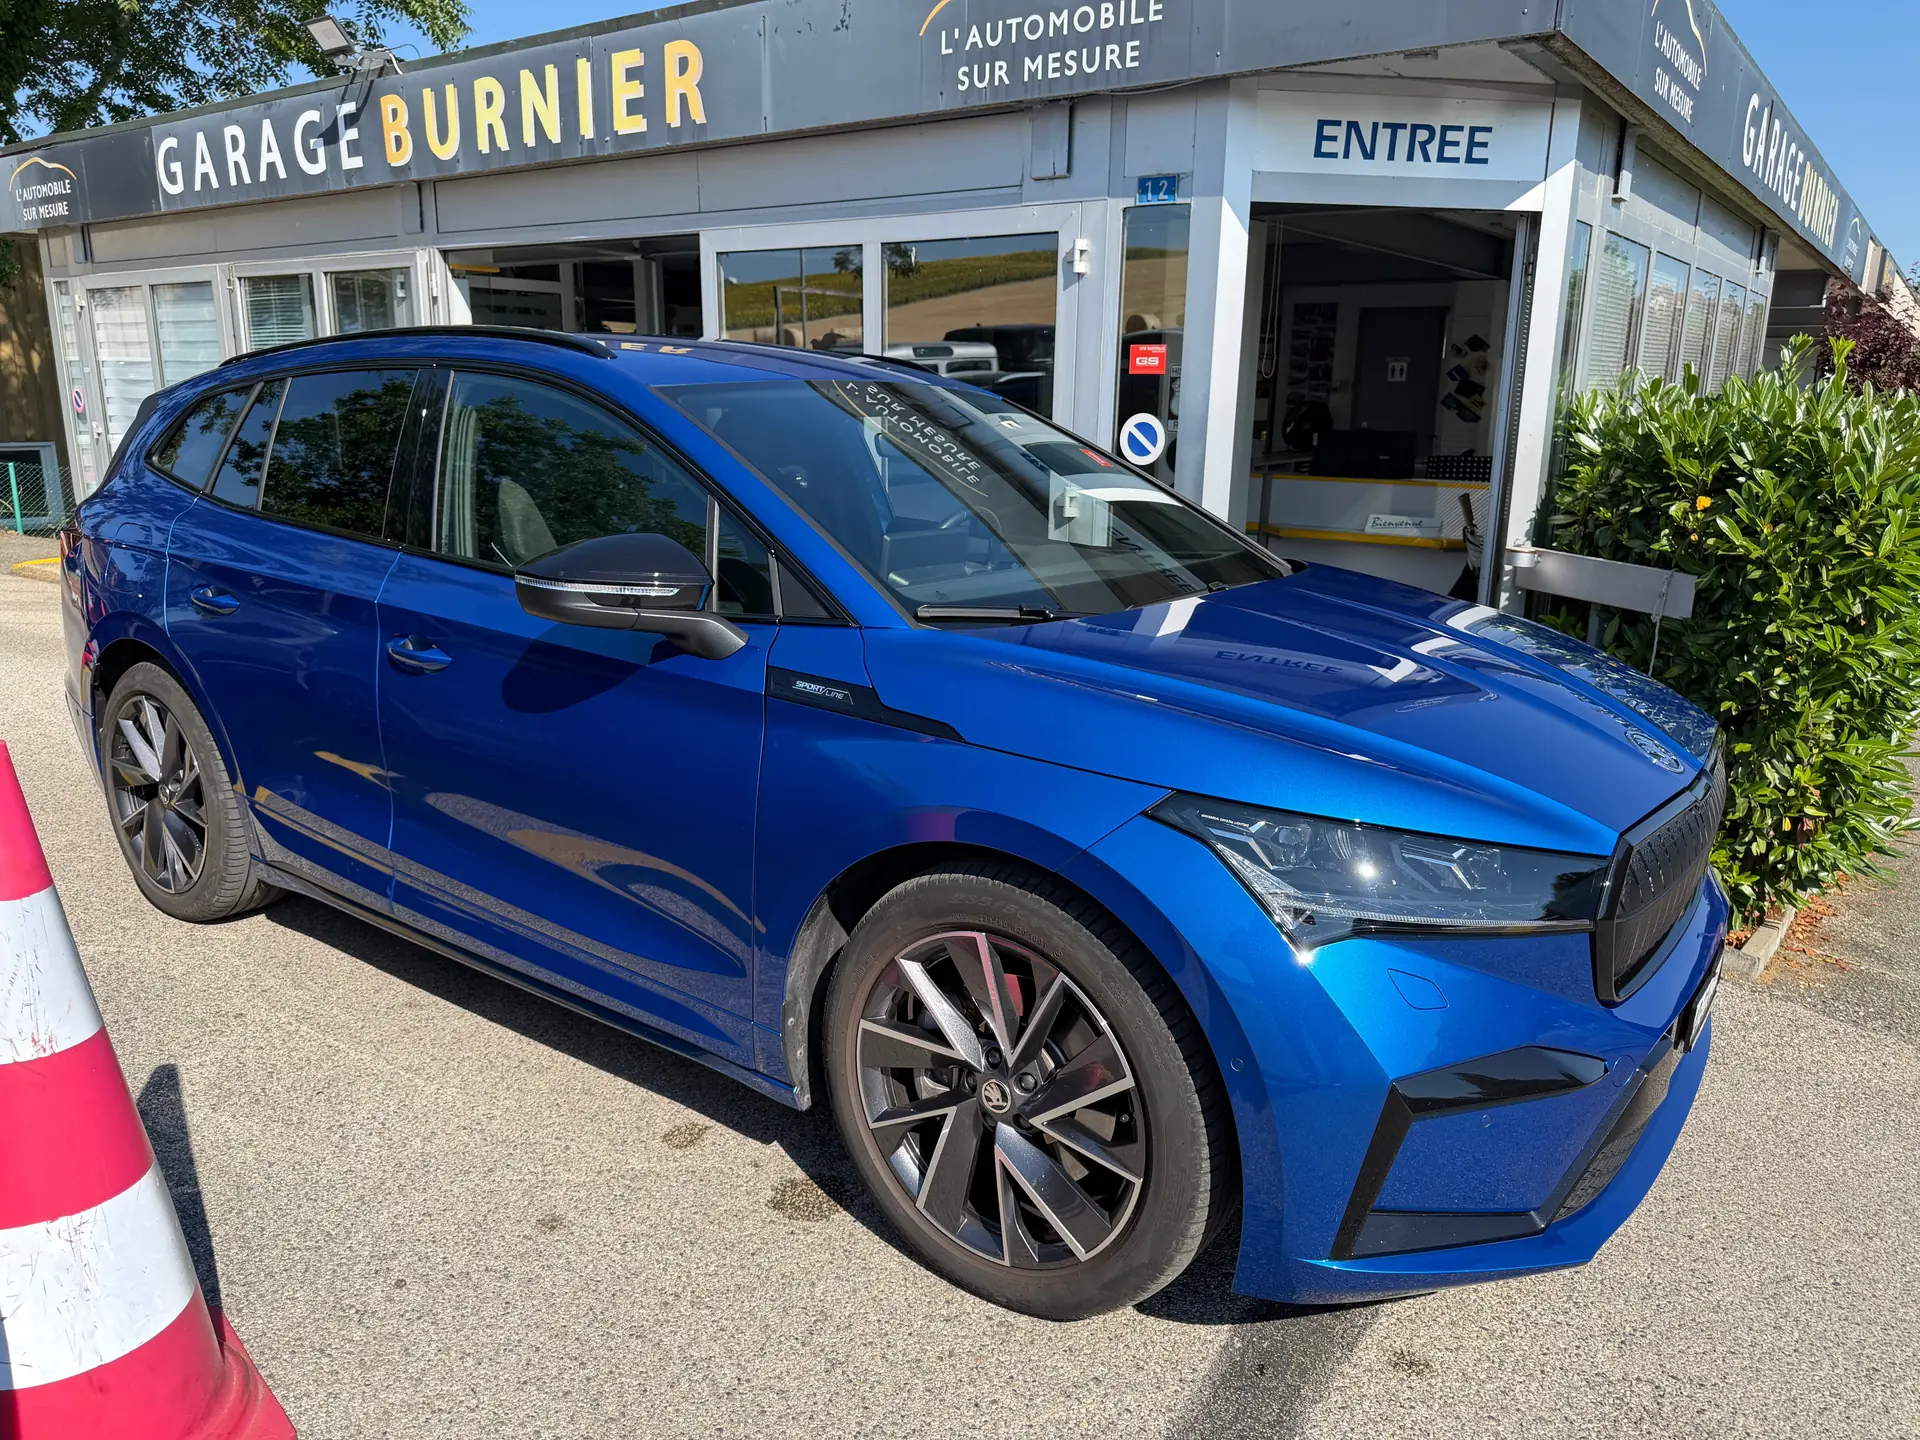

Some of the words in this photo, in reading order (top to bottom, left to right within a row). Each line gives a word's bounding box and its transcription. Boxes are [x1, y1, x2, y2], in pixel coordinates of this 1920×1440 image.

[941, 0, 1163, 55] L'AUTOMOBILE
[957, 61, 1010, 91] SUR
[1023, 40, 1140, 82] MESURE
[1654, 20, 1702, 91] L'AUTOMOBILE
[157, 101, 364, 195] GARAGE
[380, 39, 707, 167] BURNIER
[1654, 66, 1669, 101] SUR
[1668, 81, 1694, 124] MESURE
[1313, 119, 1493, 165] ENTREE
[1742, 93, 1804, 212] GARAGE
[15, 179, 72, 202] L'AUTOMOBILE
[23, 208, 38, 221] SUR
[40, 201, 69, 219] MESURE
[1145, 180, 1169, 201] 12
[1135, 356, 1159, 367] GS
[1371, 516, 1423, 529] Bienvenue
